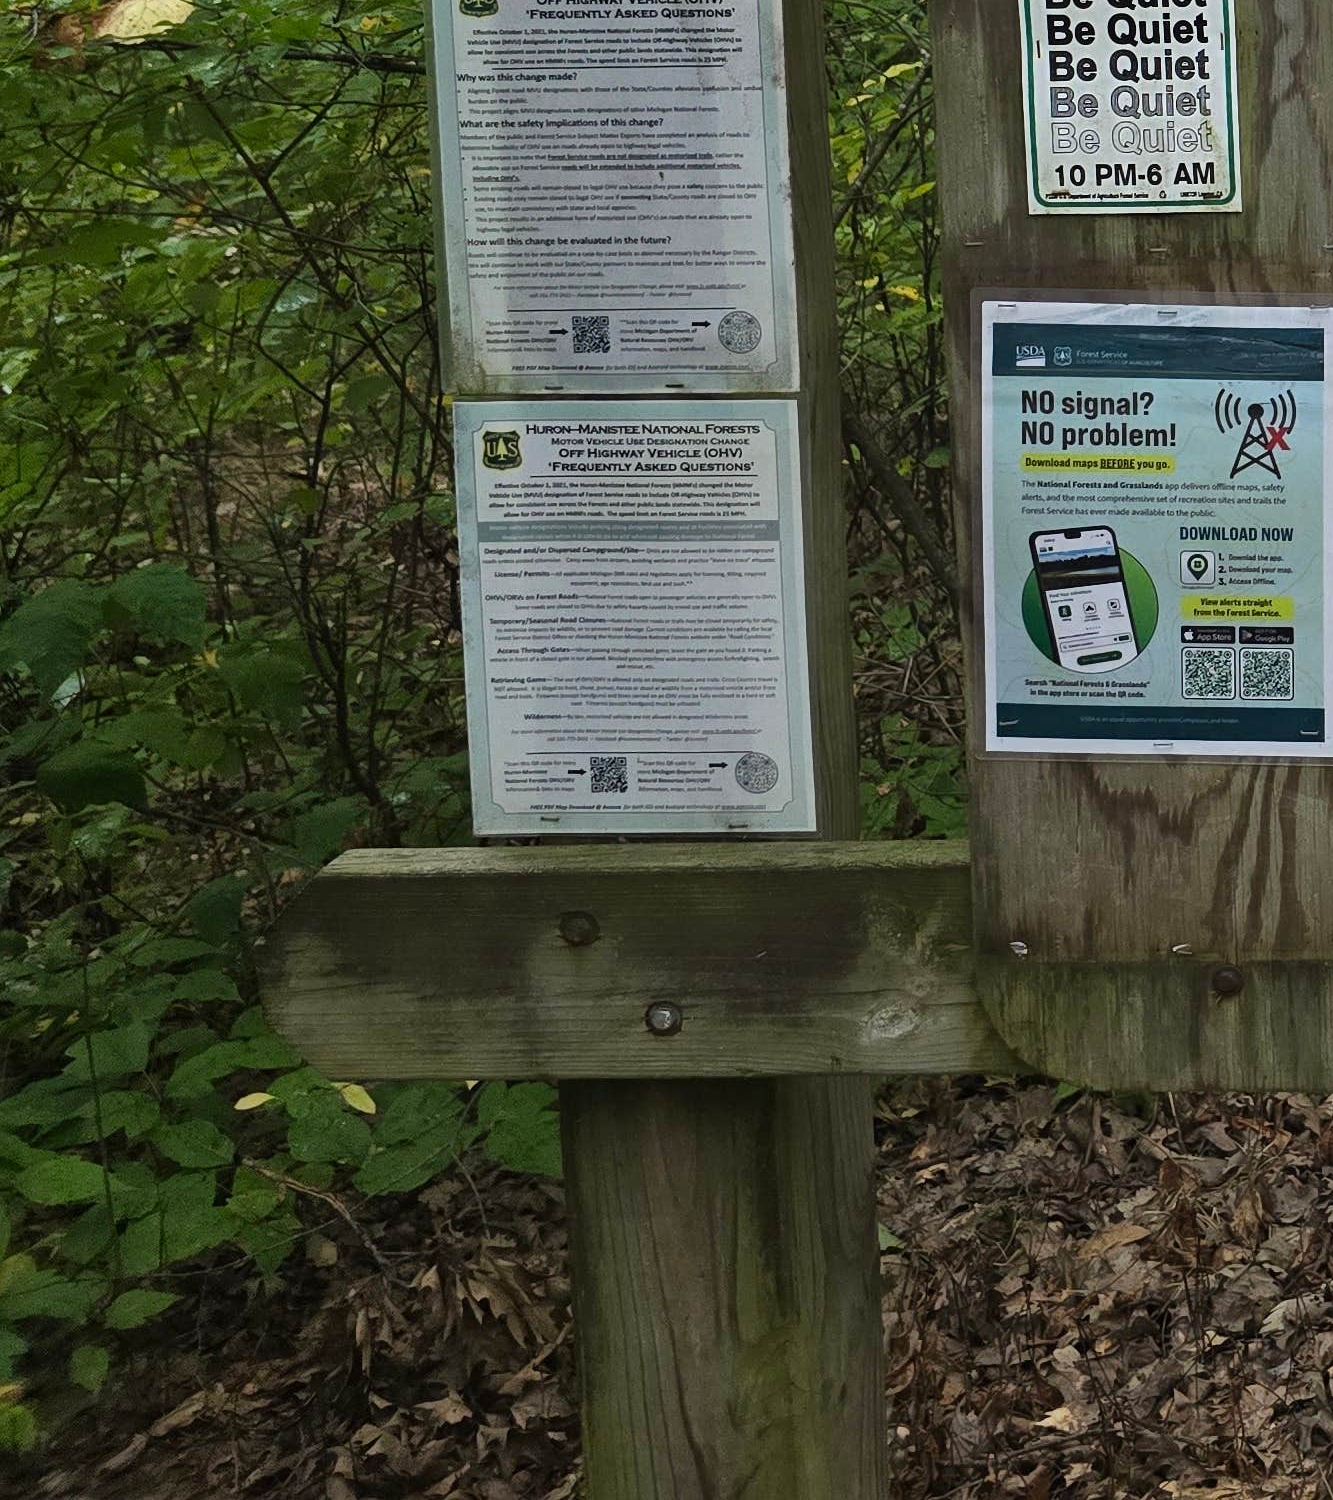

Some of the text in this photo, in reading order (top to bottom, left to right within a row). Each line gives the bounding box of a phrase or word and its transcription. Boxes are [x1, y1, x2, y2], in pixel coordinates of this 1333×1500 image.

[457, 73, 476, 83] Why
[498, 73, 513, 81] this
[515, 72, 547, 82] change
[549, 72, 577, 81] made?
[1055, 162, 1214, 186] 10 PM-6 AM
[1021, 390, 1154, 419] NO signal?
[1021, 421, 1176, 450] NO problem!
[1025, 457, 1170, 470] Download maps BEFORE you go.
[1179, 526, 1293, 541] DOWNLOAD NOW
